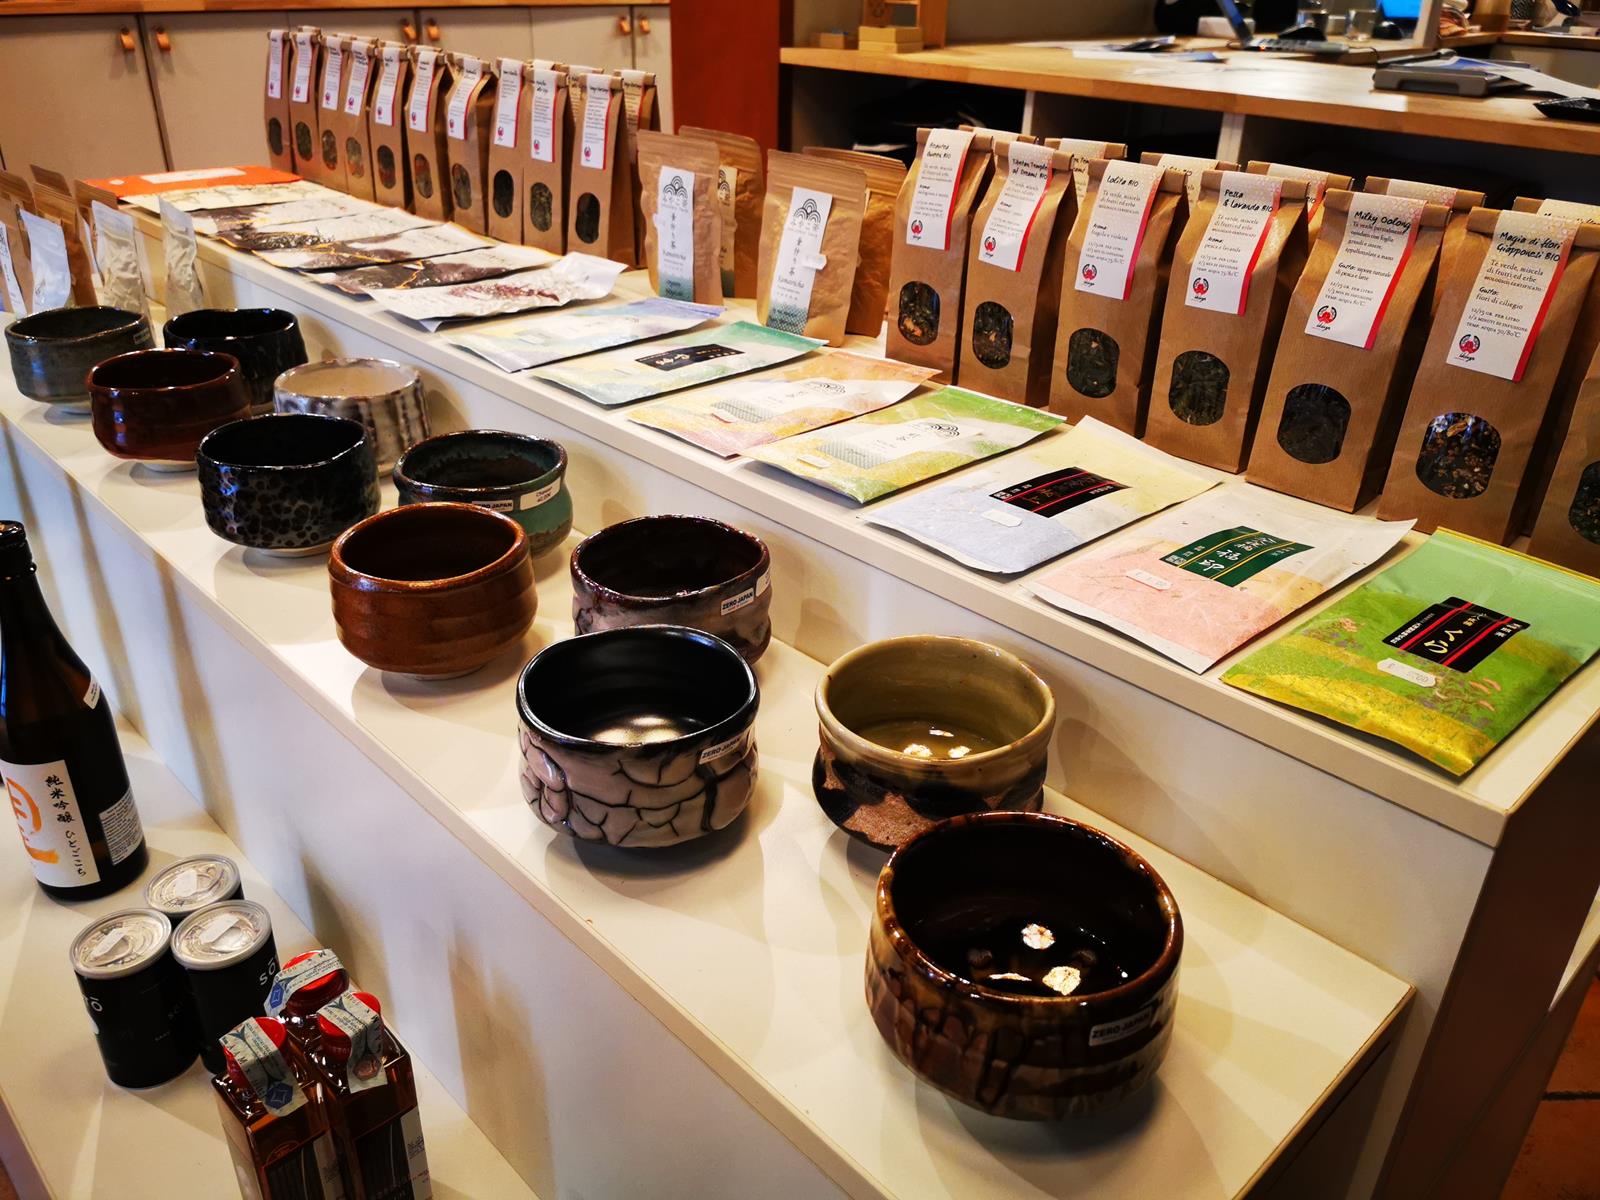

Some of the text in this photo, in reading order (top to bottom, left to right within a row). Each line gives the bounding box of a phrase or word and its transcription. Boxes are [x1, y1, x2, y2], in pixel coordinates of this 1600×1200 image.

[1354, 211, 1412, 232] Milky Oolong
[1500, 232, 1527, 246] Magia
[1529, 236, 1539, 246] di
[1544, 252, 1560, 262] BIO
[722, 592, 753, 610] ZERO JAPAN
[702, 748, 721, 759] ZERO
[45, 774, 87, 878] 純米吟醸 ひとごこち
